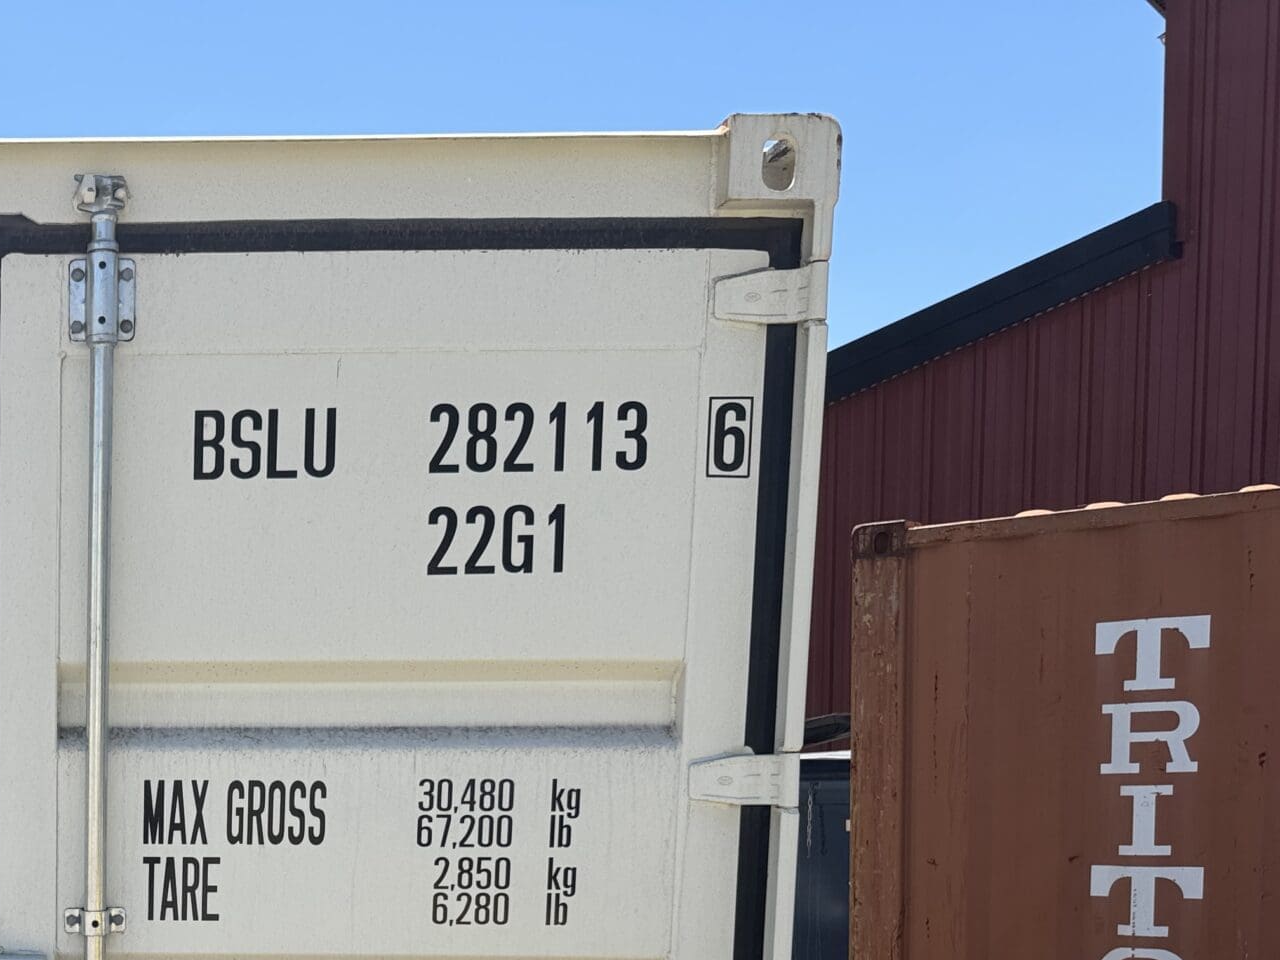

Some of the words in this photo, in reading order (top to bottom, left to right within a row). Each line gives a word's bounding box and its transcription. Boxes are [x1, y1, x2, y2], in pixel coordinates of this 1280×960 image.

[193, 407, 338, 481] BSLU
[428, 400, 648, 474] 282113
[713, 401, 747, 472] 6
[426, 503, 567, 576] 22G1
[142, 779, 209, 845] MAX
[226, 779, 327, 846] GROSS
[417, 778, 516, 814] 30,480
[550, 778, 581, 819] kg
[416, 814, 514, 850] 67,200
[548, 815, 572, 849] lb
[142, 856, 221, 922] TARE
[433, 856, 511, 892] 2,850
[547, 857, 578, 897] kg
[431, 892, 510, 927] 6,280
[545, 893, 568, 926] lb
